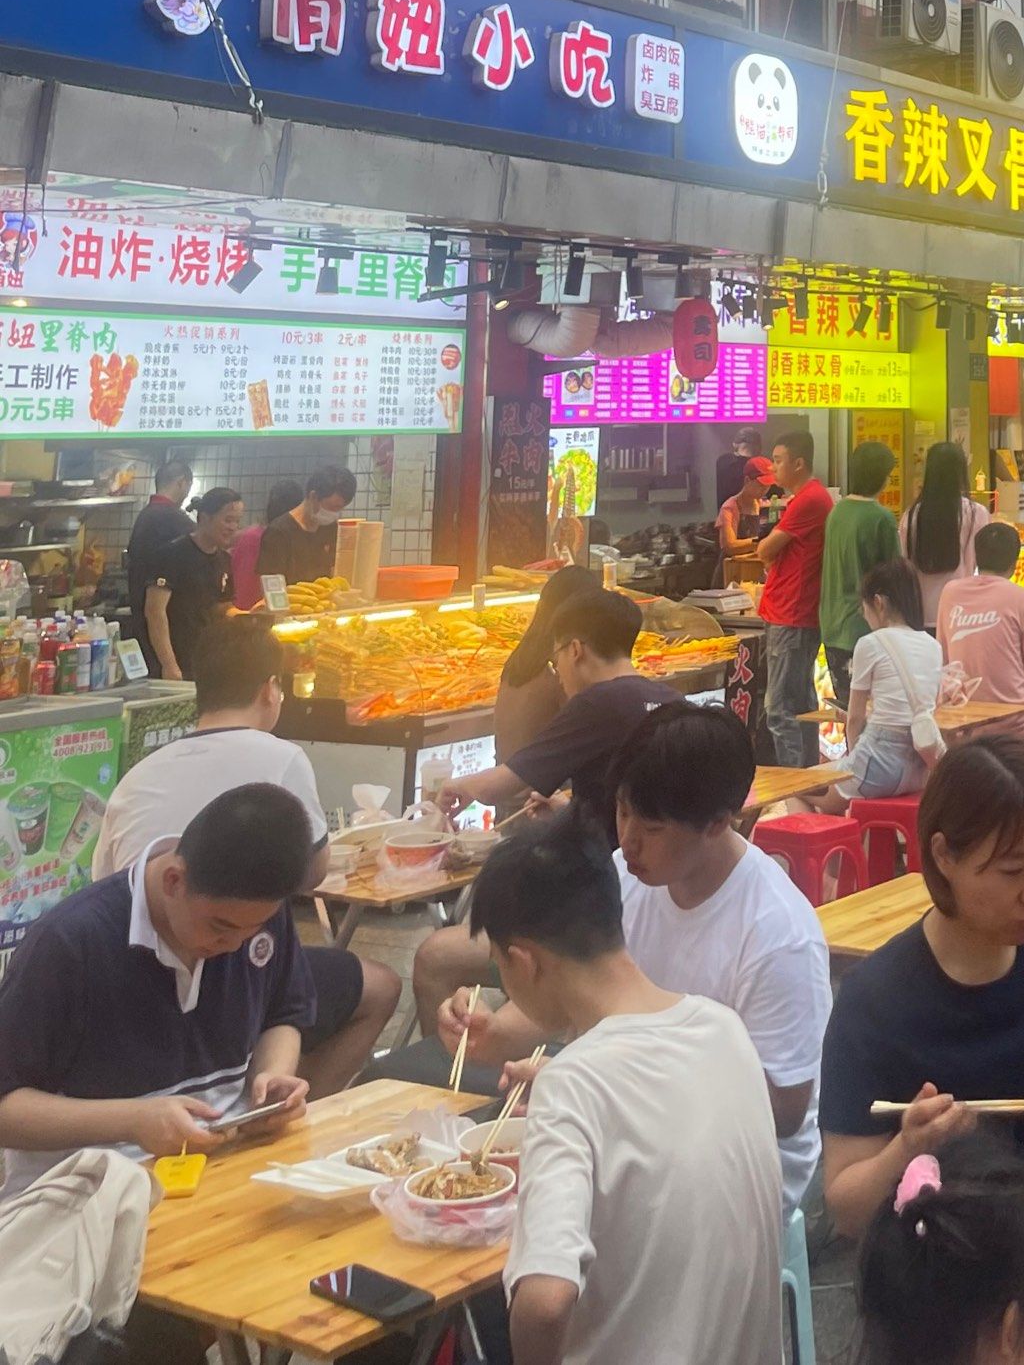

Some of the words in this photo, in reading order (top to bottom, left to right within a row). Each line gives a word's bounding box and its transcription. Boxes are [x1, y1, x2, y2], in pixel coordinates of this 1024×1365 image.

[641, 39, 681, 67] 卤肉饭
[640, 90, 679, 117] 臭豆腐
[781, 351, 841, 378] 香辣叉骨
[949, 605, 998, 629] Puma
